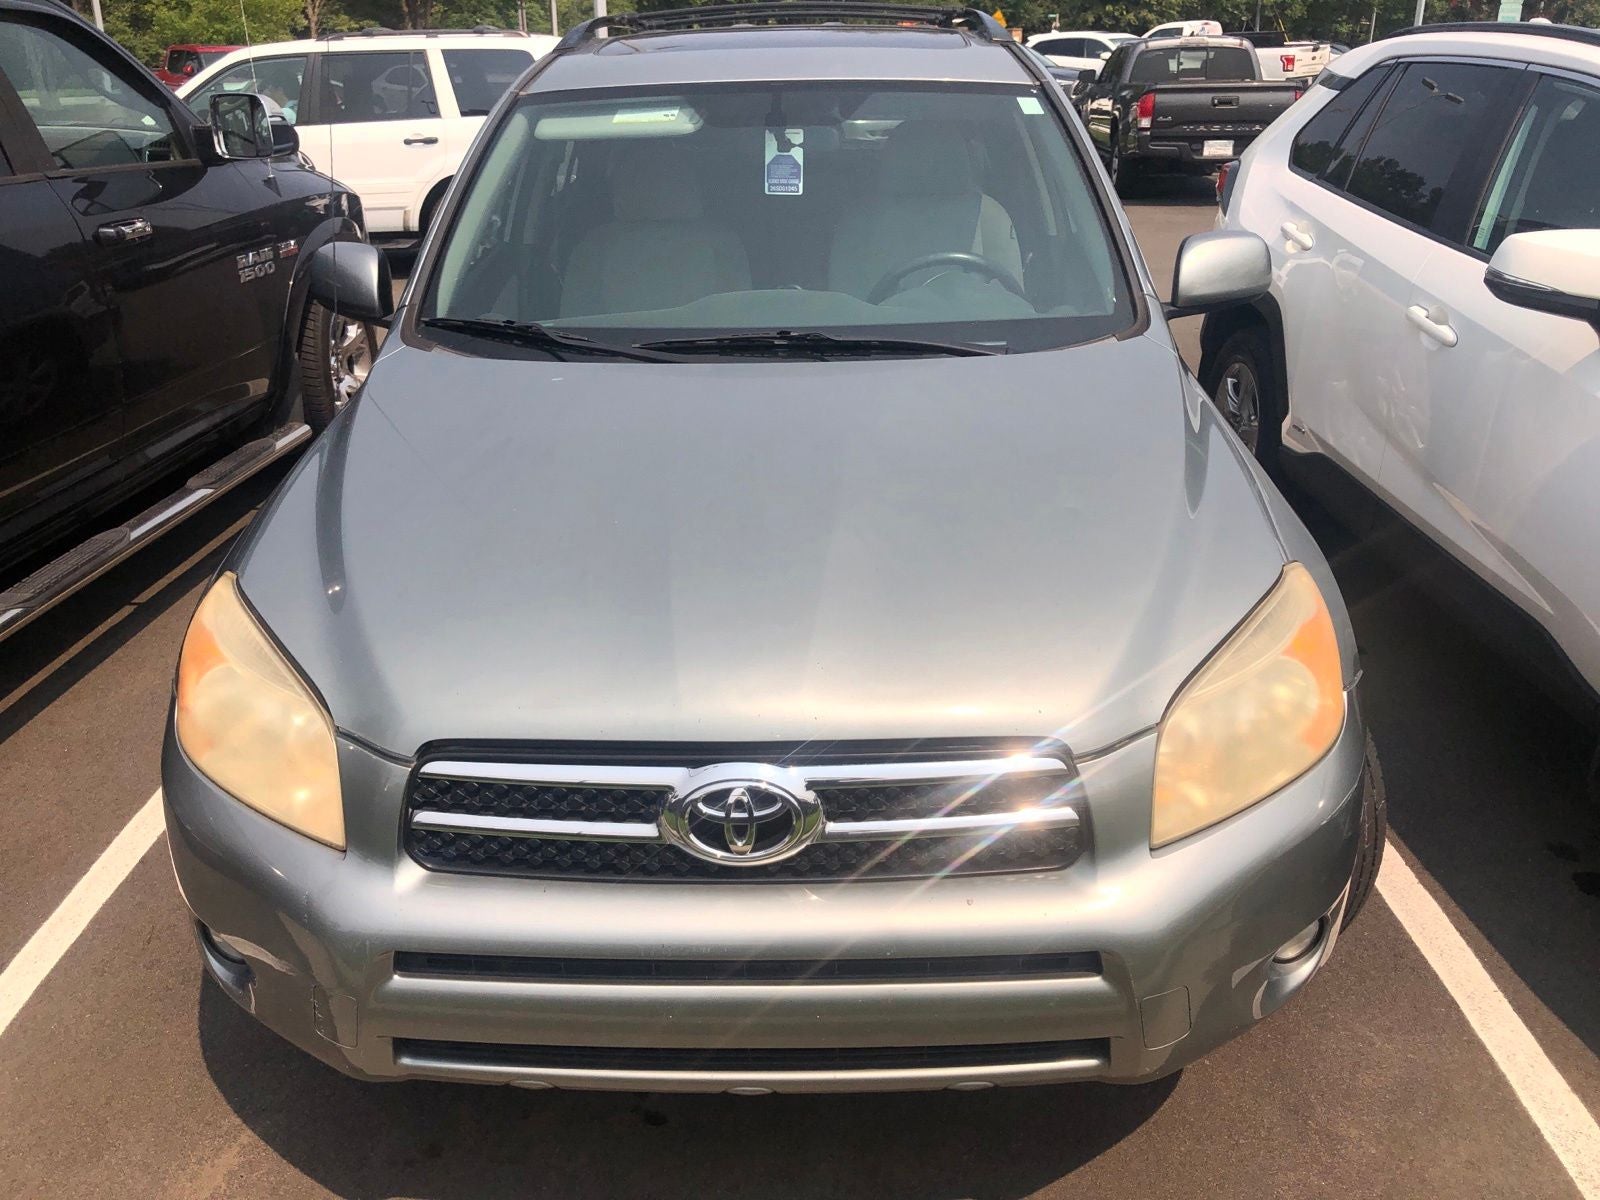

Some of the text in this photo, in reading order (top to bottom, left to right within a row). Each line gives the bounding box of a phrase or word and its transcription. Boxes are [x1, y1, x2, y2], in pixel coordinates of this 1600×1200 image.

[1182, 124, 1263, 132] TACOMA
[236, 246, 274, 270] RAM
[238, 261, 275, 284] 1500
